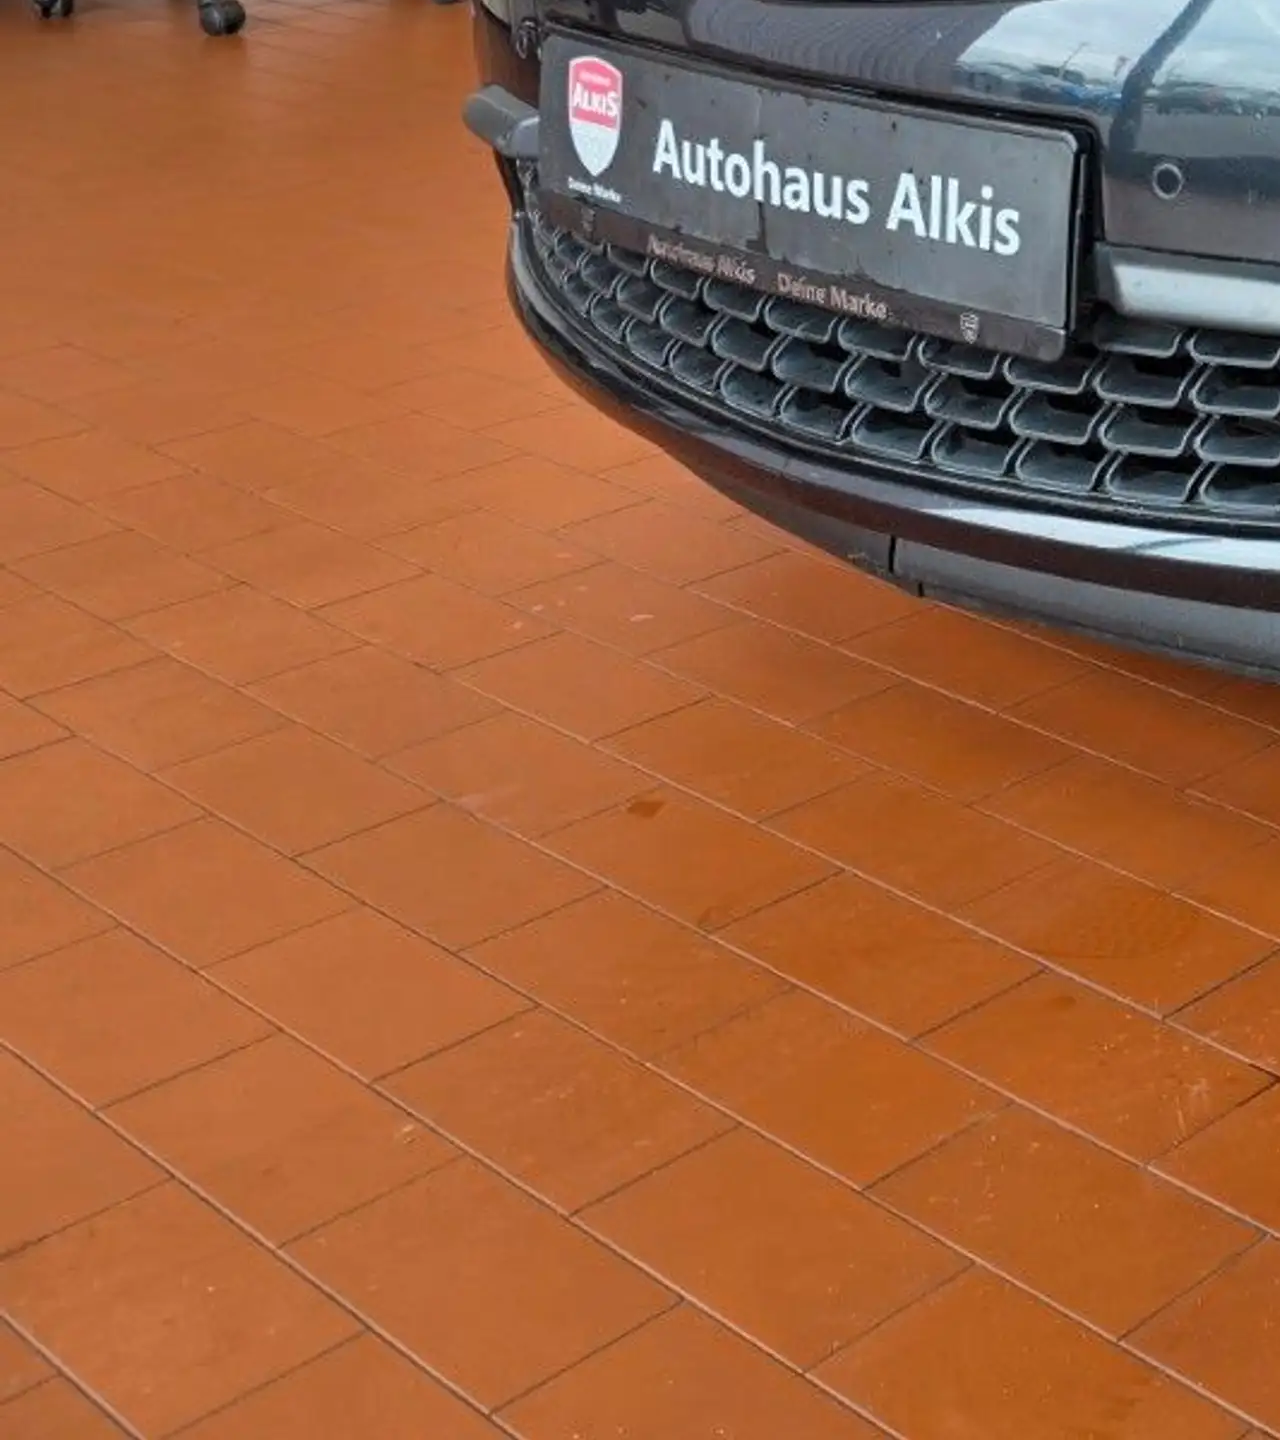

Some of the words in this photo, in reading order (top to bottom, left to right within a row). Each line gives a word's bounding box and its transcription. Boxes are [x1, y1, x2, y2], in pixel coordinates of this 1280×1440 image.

[653, 118, 871, 225] Autohaus
[886, 172, 1021, 256] Alkis
[829, 285, 887, 321] Marke
